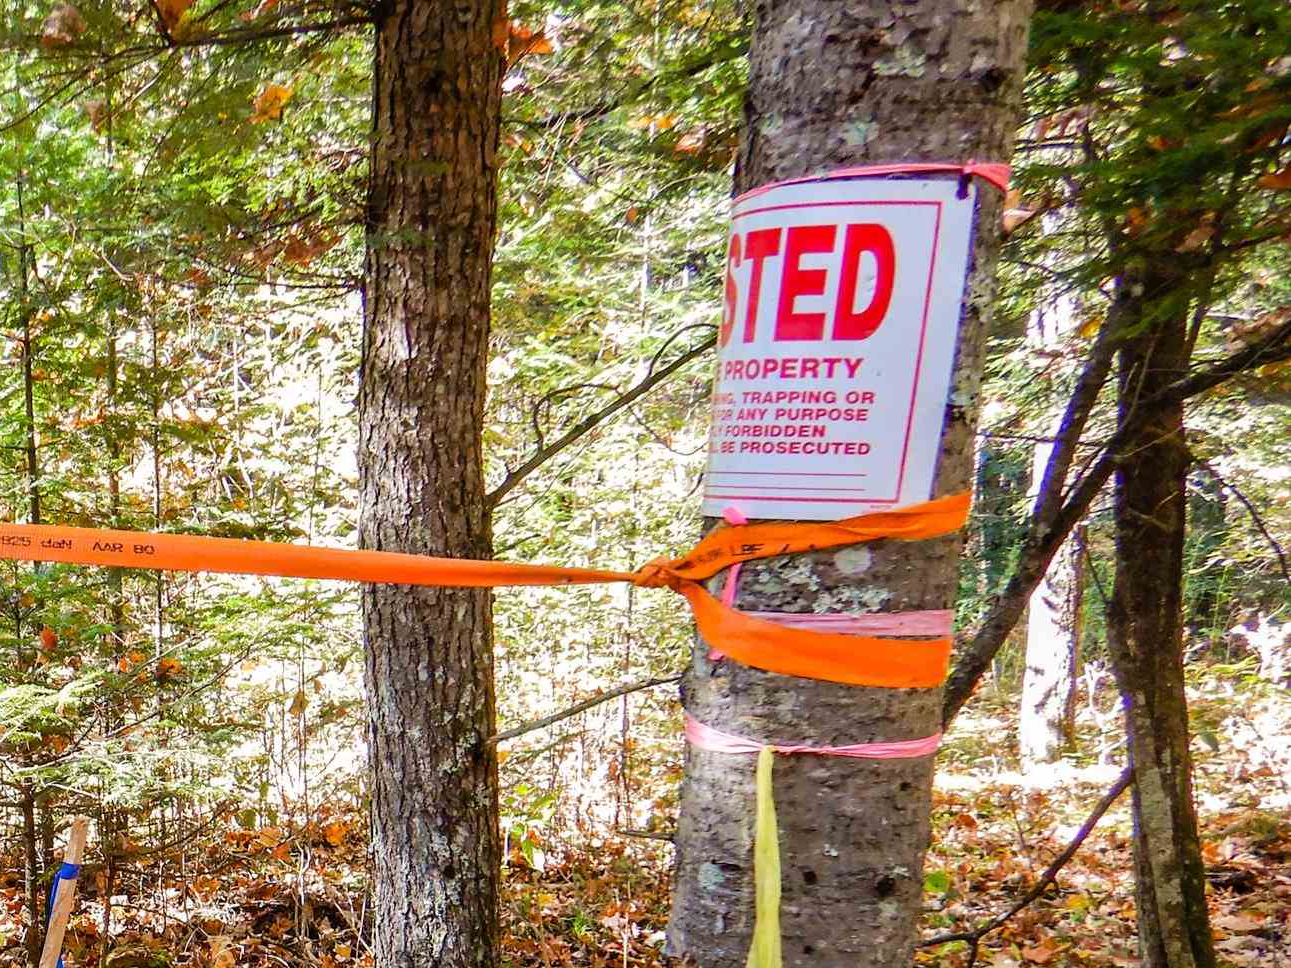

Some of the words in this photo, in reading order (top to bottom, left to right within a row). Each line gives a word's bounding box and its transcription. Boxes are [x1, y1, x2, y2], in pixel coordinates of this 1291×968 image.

[724, 357, 865, 381] PROPERTY
[741, 391, 837, 404] TRAPPING
[845, 391, 875, 404] OR
[737, 409, 768, 421] ANY
[774, 408, 869, 421] PURPOSE
[726, 425, 826, 438] FORBIDDEN
[741, 441, 871, 455] PROSECUTED
